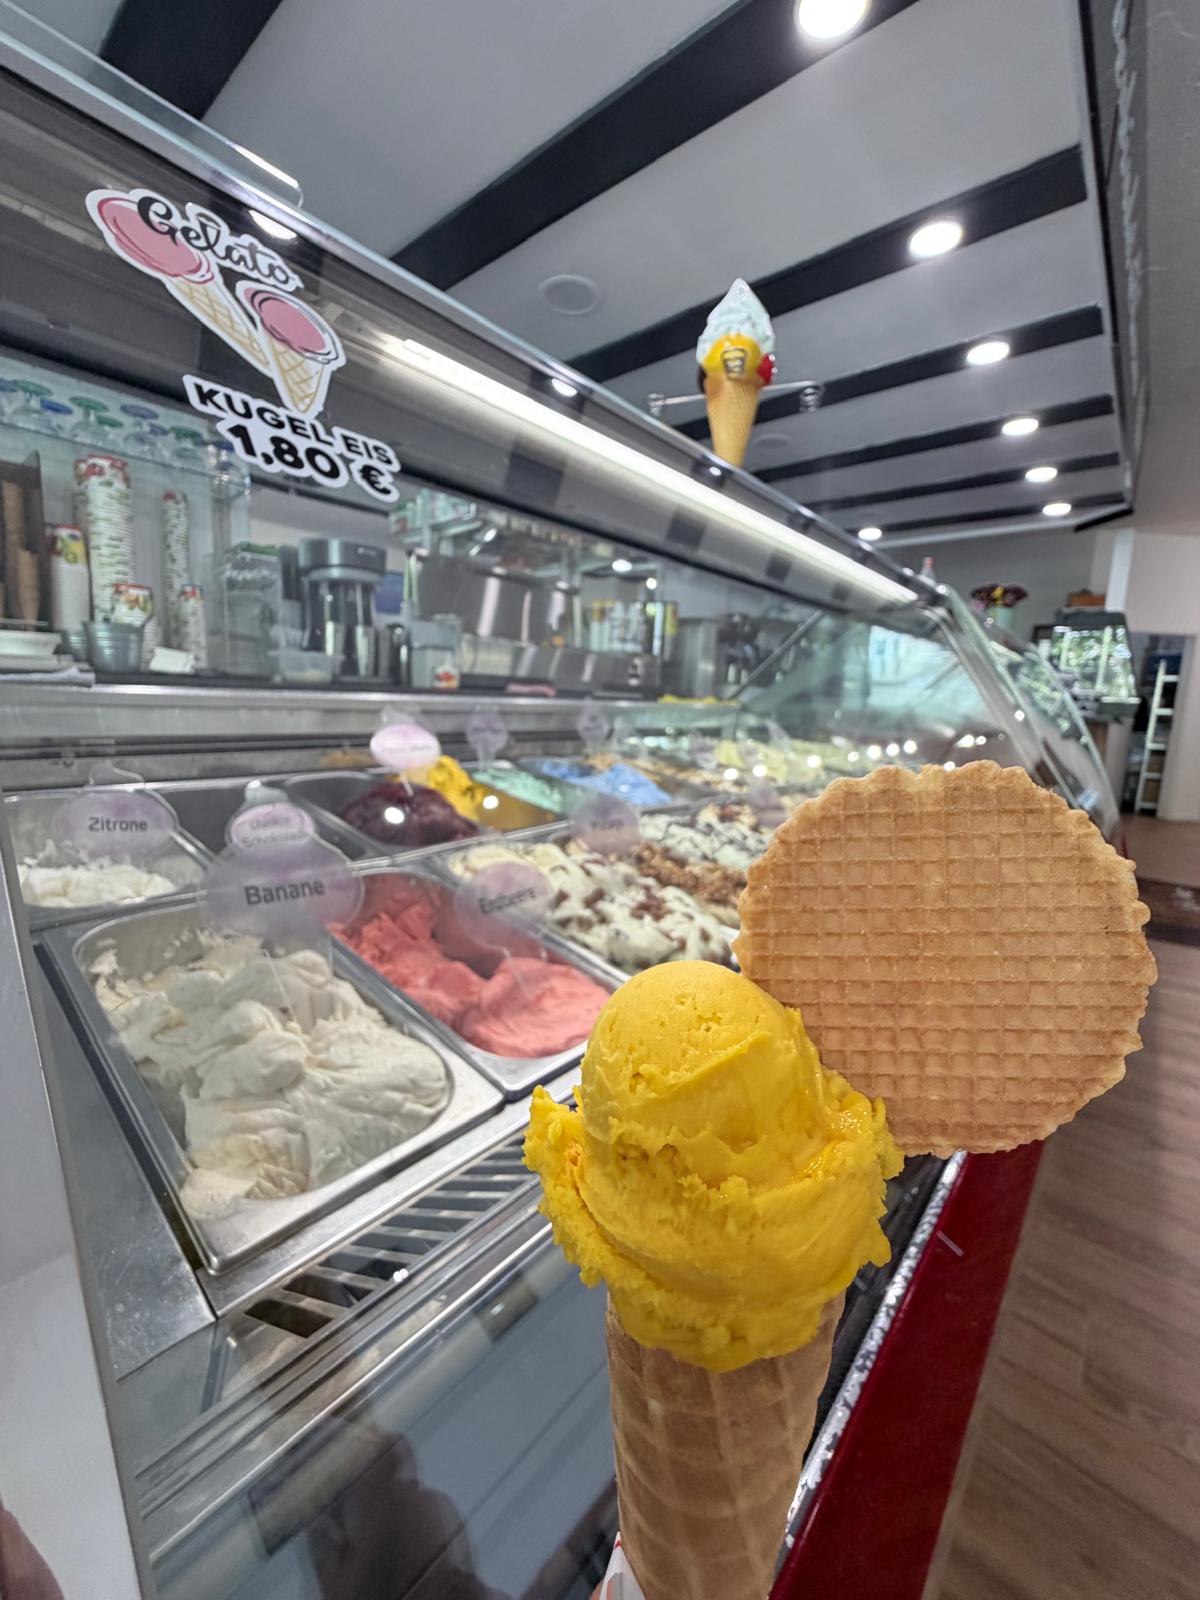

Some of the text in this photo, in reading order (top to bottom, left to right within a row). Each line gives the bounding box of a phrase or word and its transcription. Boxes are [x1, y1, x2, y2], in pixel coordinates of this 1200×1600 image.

[137, 196, 292, 284] Gelato
[194, 382, 394, 466] KUGEL EIS
[227, 424, 392, 496] 1,80 €
[88, 816, 148, 832] Zitrone
[244, 878, 326, 906] Banane
